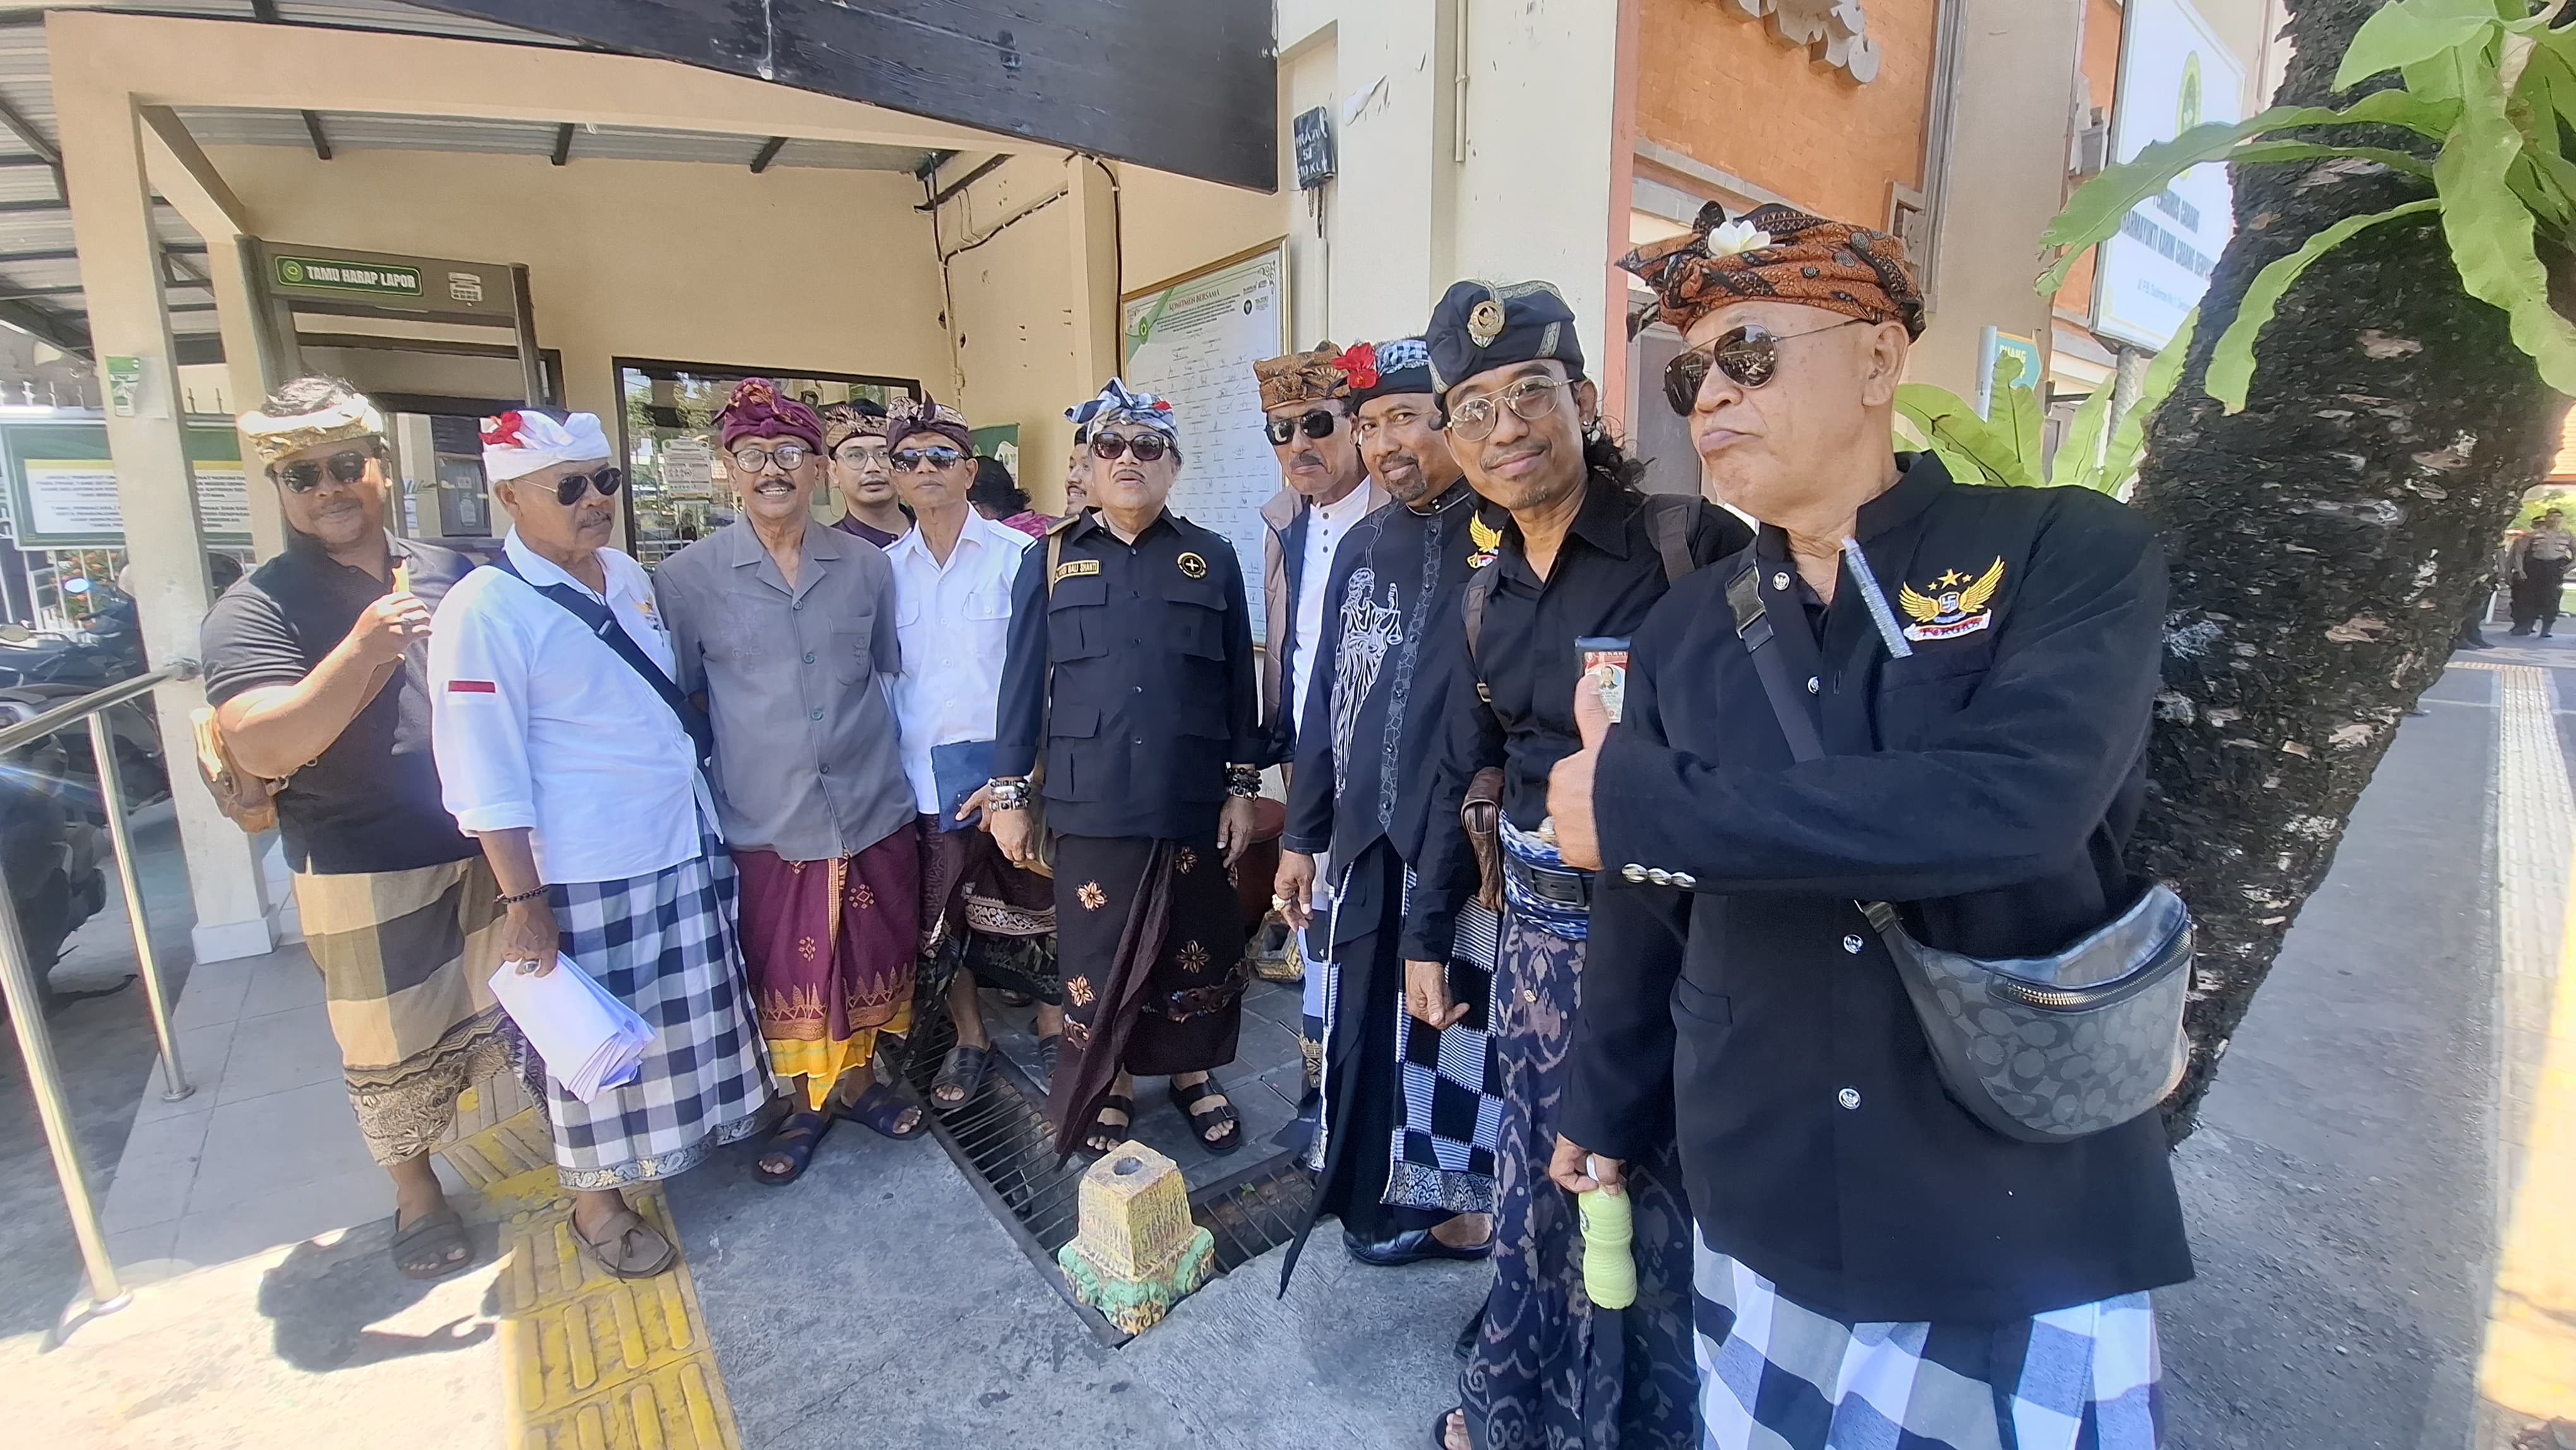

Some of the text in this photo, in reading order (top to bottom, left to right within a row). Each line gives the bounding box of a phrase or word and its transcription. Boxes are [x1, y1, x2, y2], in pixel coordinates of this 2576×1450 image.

[306, 266, 416, 289] TAMU HARAP LAPOR
